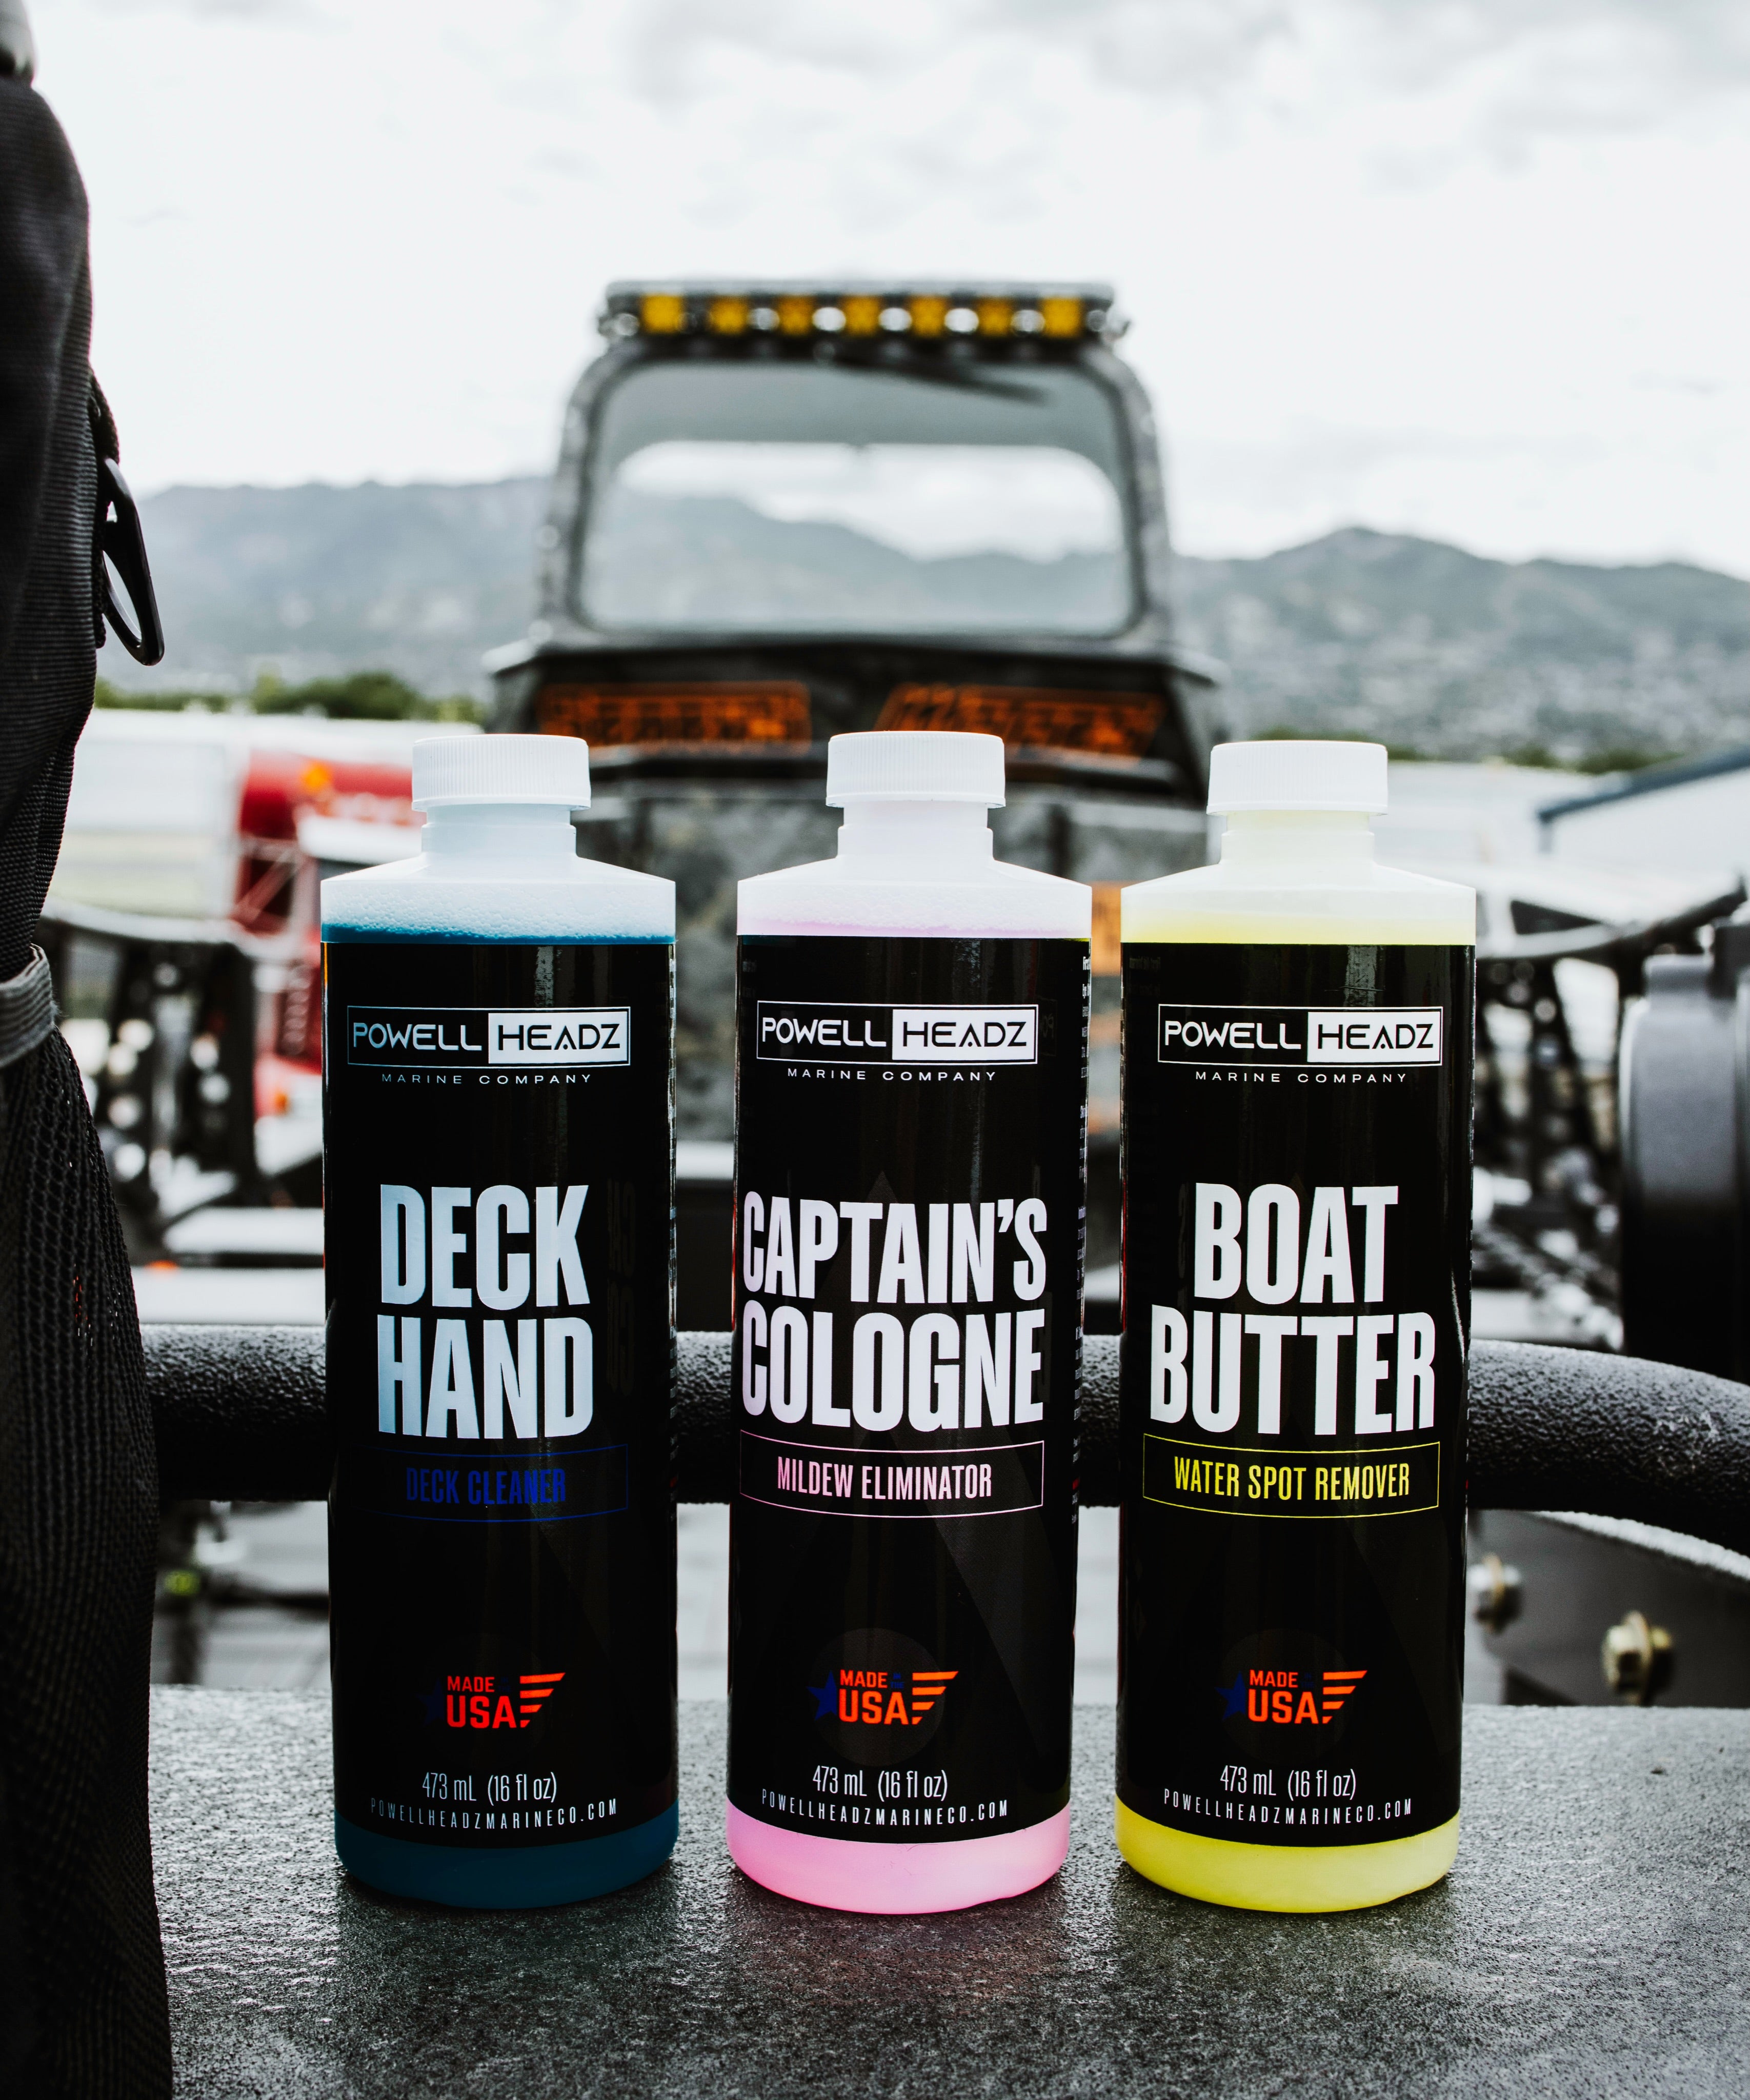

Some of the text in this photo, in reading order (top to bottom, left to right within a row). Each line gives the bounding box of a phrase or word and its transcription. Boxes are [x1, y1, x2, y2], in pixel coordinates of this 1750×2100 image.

[354, 1022, 620, 1051] POWELL HEADZ
[762, 1017, 887, 1047] POWELL
[903, 1022, 1026, 1047] HEADZ
[1165, 1021, 1433, 1049] POWELL HEADZ
[383, 1074, 590, 1084] MARINE COMPANY
[788, 1068, 995, 1081] MARINE COMPANY
[1196, 1072, 1405, 1083] MARINE COMPANY
[380, 1184, 590, 1310] DECK
[743, 1191, 1048, 1303] CAPTAIN’S
[1195, 1183, 1398, 1304] BOAT
[377, 1315, 593, 1439] HAND
[742, 1300, 1045, 1432] COLOGNE
[1151, 1304, 1436, 1435] BUTTER
[408, 1468, 565, 1504] DECK CLEANER
[778, 1457, 991, 1500] MILDEW ELIMINATOR
[1175, 1457, 1409, 1500] WATER SPOT REMOVER
[448, 1676, 494, 1692] MADE
[840, 1669, 888, 1688] MADE
[1250, 1670, 1298, 1688] MADE
[447, 1695, 516, 1728] USA
[839, 1689, 909, 1725] USA
[1249, 1689, 1319, 1724] USA
[423, 1772, 556, 1806] 473 mL (16 fl oz)
[813, 1765, 947, 1801] 473 mL (16 fl oz)
[1220, 1765, 1356, 1801] 473 mL (16 fl oz)
[371, 1799, 617, 1829] POWELLHEADZMARINECO.COM
[762, 1789, 1007, 1825] POWELLHEADZMARINECO.COM
[1164, 1789, 1411, 1824] POWELLHEADZMARINECO.COM
